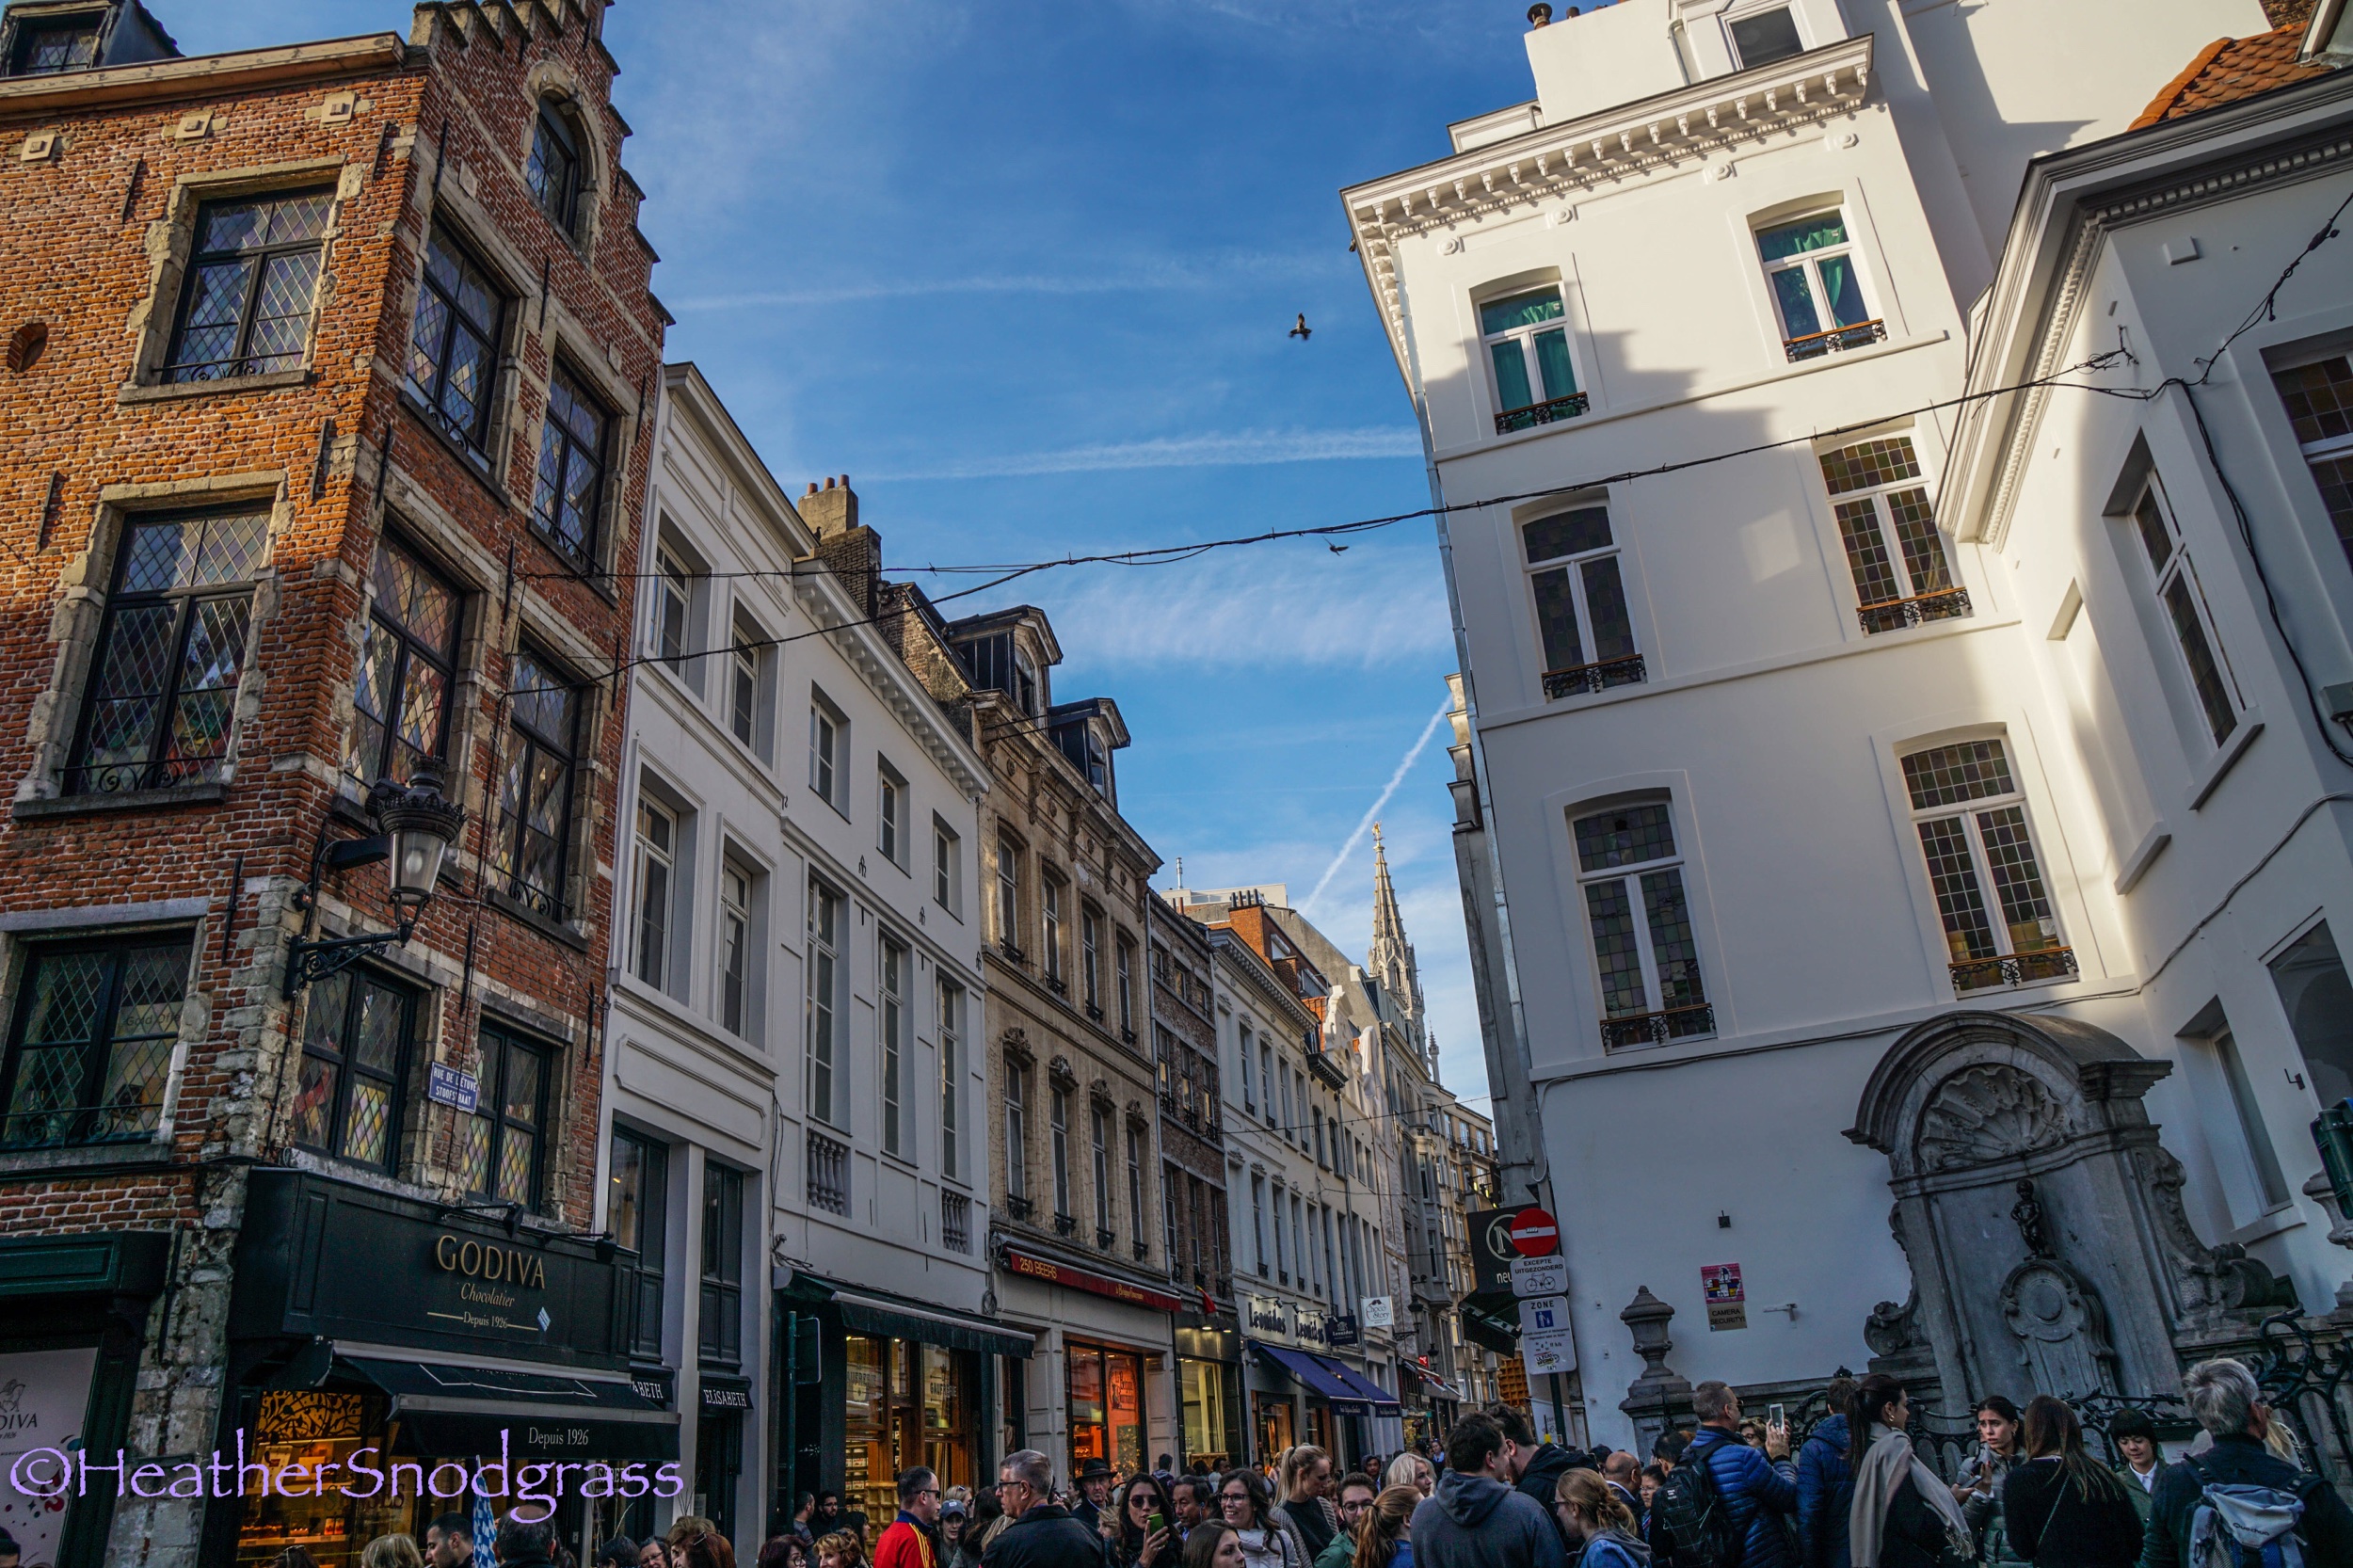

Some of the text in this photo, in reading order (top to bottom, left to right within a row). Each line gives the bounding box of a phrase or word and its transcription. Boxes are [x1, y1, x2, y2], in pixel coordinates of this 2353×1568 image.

[434, 1066, 477, 1093] RUE DE LÉTUVE
[436, 1085, 472, 1106] STOOFSRAAT
[437, 1234, 545, 1289] GODIVA
[1019, 1257, 1058, 1280] 250 BEERS
[1515, 1264, 1563, 1274] UITGEZONDERD
[460, 1282, 516, 1307] Chocolatier
[1531, 1301, 1554, 1310] ZONE
[1711, 1308, 1741, 1317] CAMERA
[463, 1311, 508, 1329] Depuis 1926
[1248, 1302, 1286, 1336] Leonidas
[1709, 1316, 1746, 1325] SECURITY!
[630, 1380, 664, 1400] ABETH
[528, 1427, 589, 1448] Depuis 1926
[2233, 1522, 2270, 1536] Quechua
